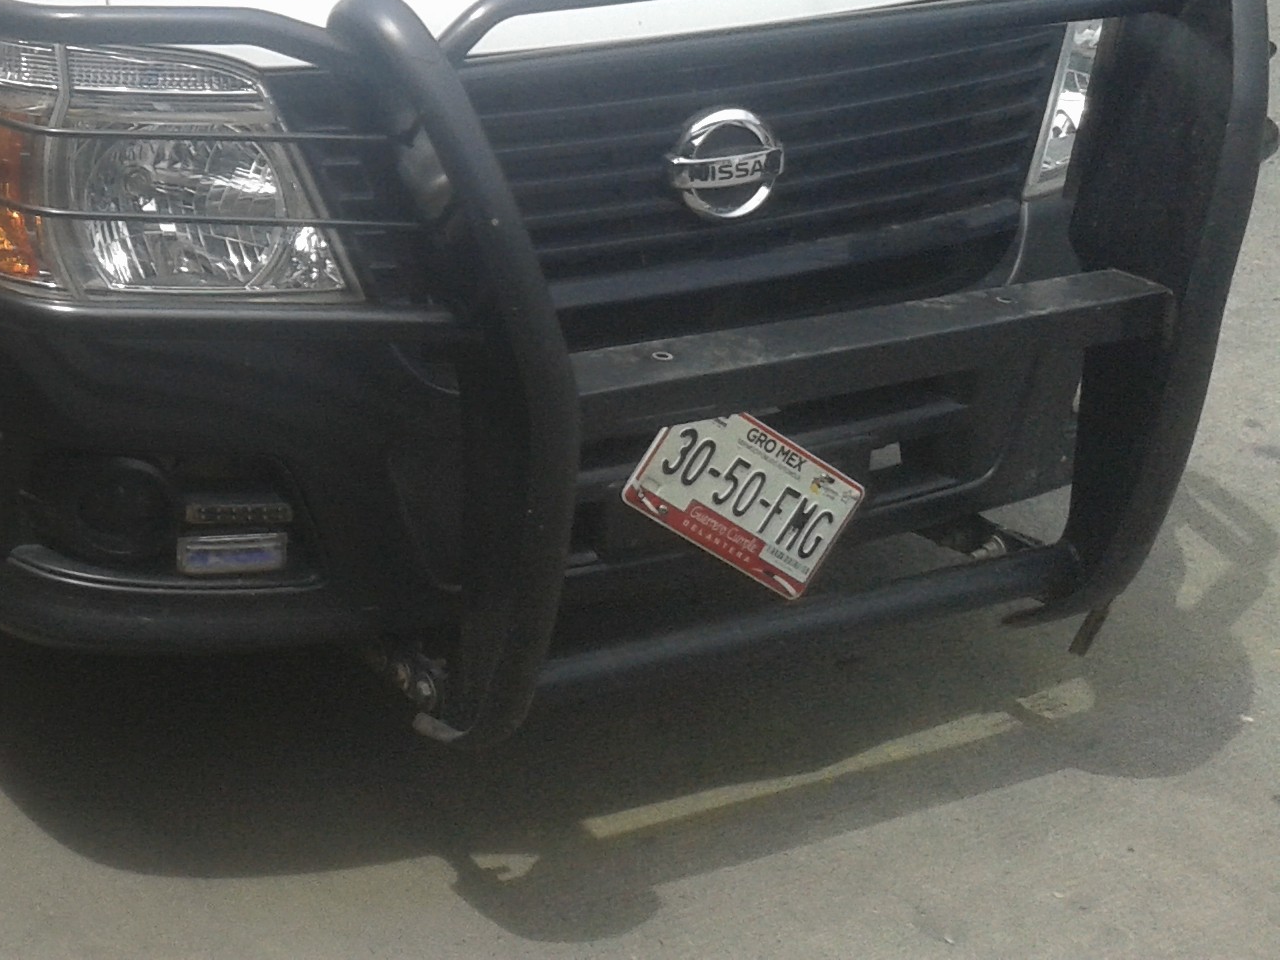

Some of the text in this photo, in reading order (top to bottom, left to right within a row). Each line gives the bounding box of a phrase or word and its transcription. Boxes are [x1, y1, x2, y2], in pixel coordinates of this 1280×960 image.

[688, 159, 768, 182] NISSA
[746, 427, 777, 454] GRO
[775, 445, 807, 473] MEX
[661, 427, 834, 559] 30-50-FMG
